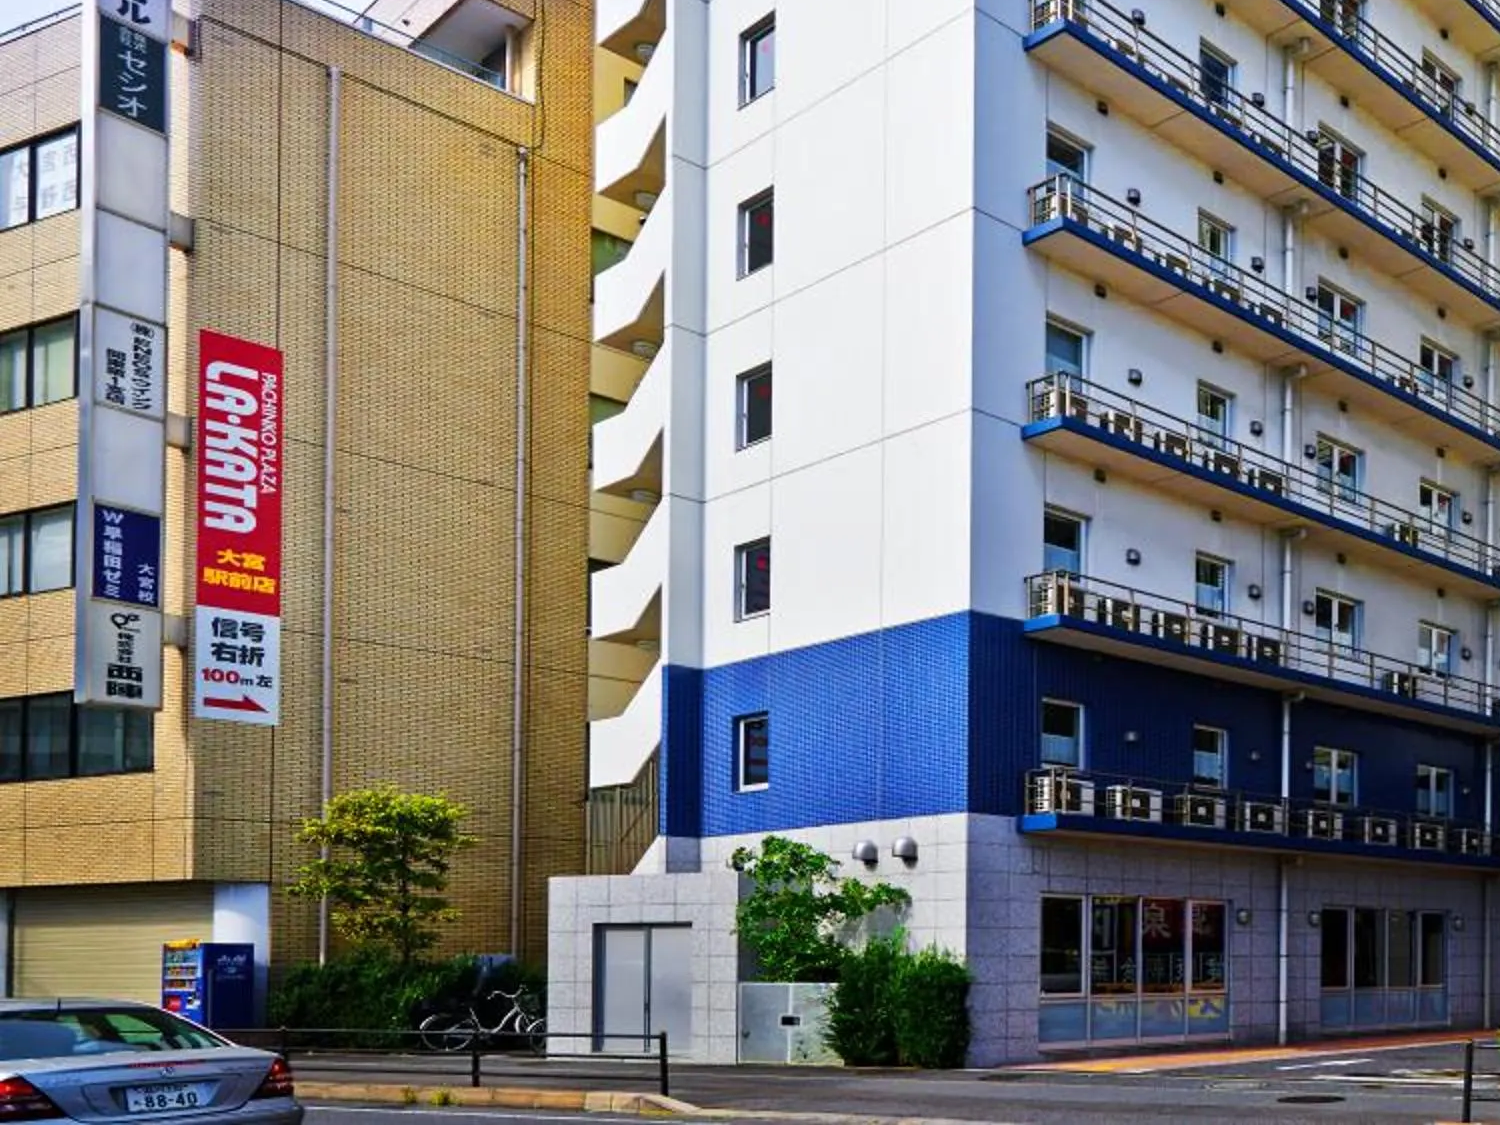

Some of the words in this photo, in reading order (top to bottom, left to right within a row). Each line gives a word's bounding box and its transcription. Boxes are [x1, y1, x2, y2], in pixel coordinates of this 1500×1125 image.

[261, 372, 277, 446] PACHINKO
[261, 448, 277, 495] PLAZA
[216, 549, 266, 571] 大宮
[203, 567, 276, 595] 駅前店
[212, 617, 265, 643] 信号
[211, 642, 265, 667] 右折
